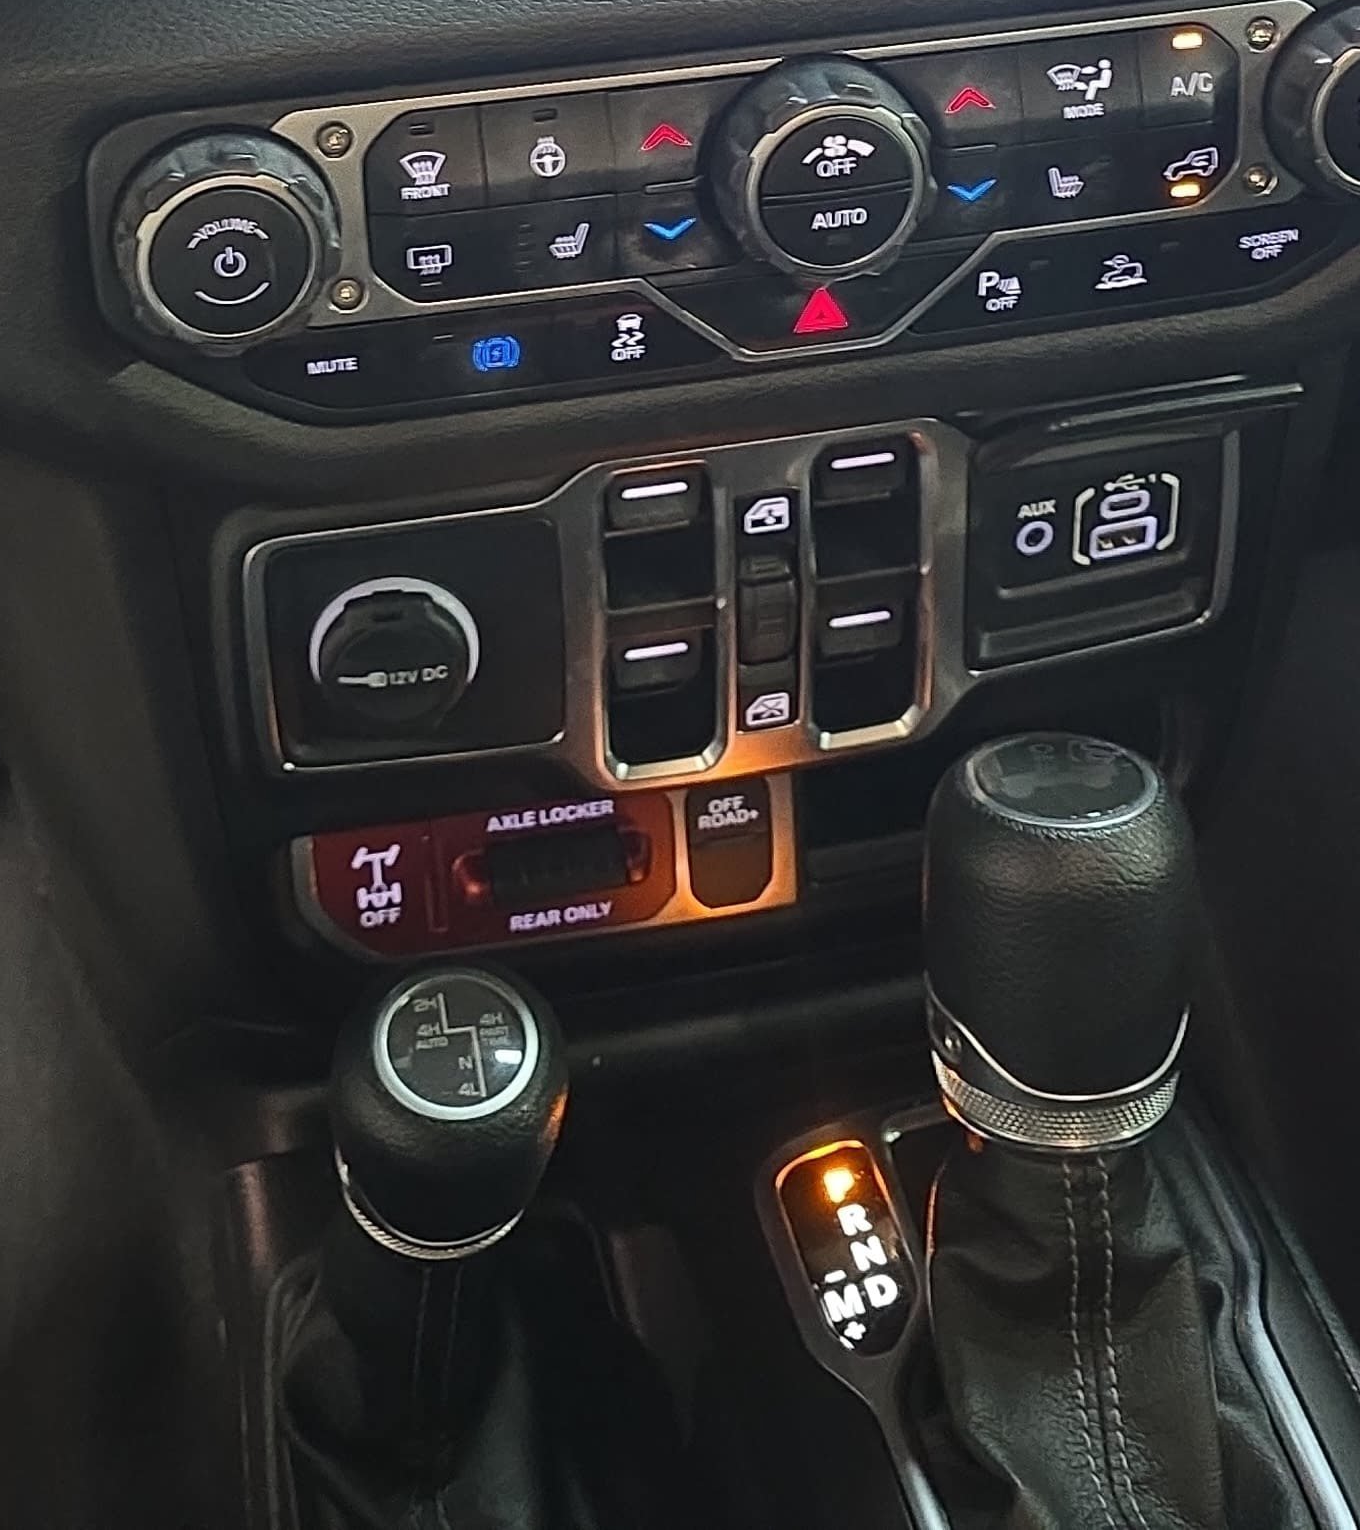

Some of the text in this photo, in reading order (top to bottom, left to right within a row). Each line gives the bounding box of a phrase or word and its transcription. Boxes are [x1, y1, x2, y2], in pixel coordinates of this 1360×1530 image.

[1170, 72, 1214, 96] A/C
[1064, 103, 1105, 118] MODE
[815, 157, 857, 178] OFF
[401, 183, 450, 200] FRONT
[196, 217, 261, 241] VOLUME
[811, 207, 868, 232] AUTO
[1238, 228, 1299, 249] SCREEN
[1251, 244, 1284, 260] OFF
[985, 295, 1019, 312] OFF
[611, 345, 646, 362] OFF
[306, 357, 359, 376] MUTE
[1017, 500, 1056, 519] AUX
[422, 664, 449, 682] DC
[707, 795, 745, 814] OFF
[487, 799, 614, 832] AXLE LOCKER
[360, 908, 401, 928] OFF
[510, 901, 612, 931] REAR ONLY
[837, 1203, 873, 1236] R
[850, 1235, 887, 1272] N
[823, 1274, 898, 1323] M D
